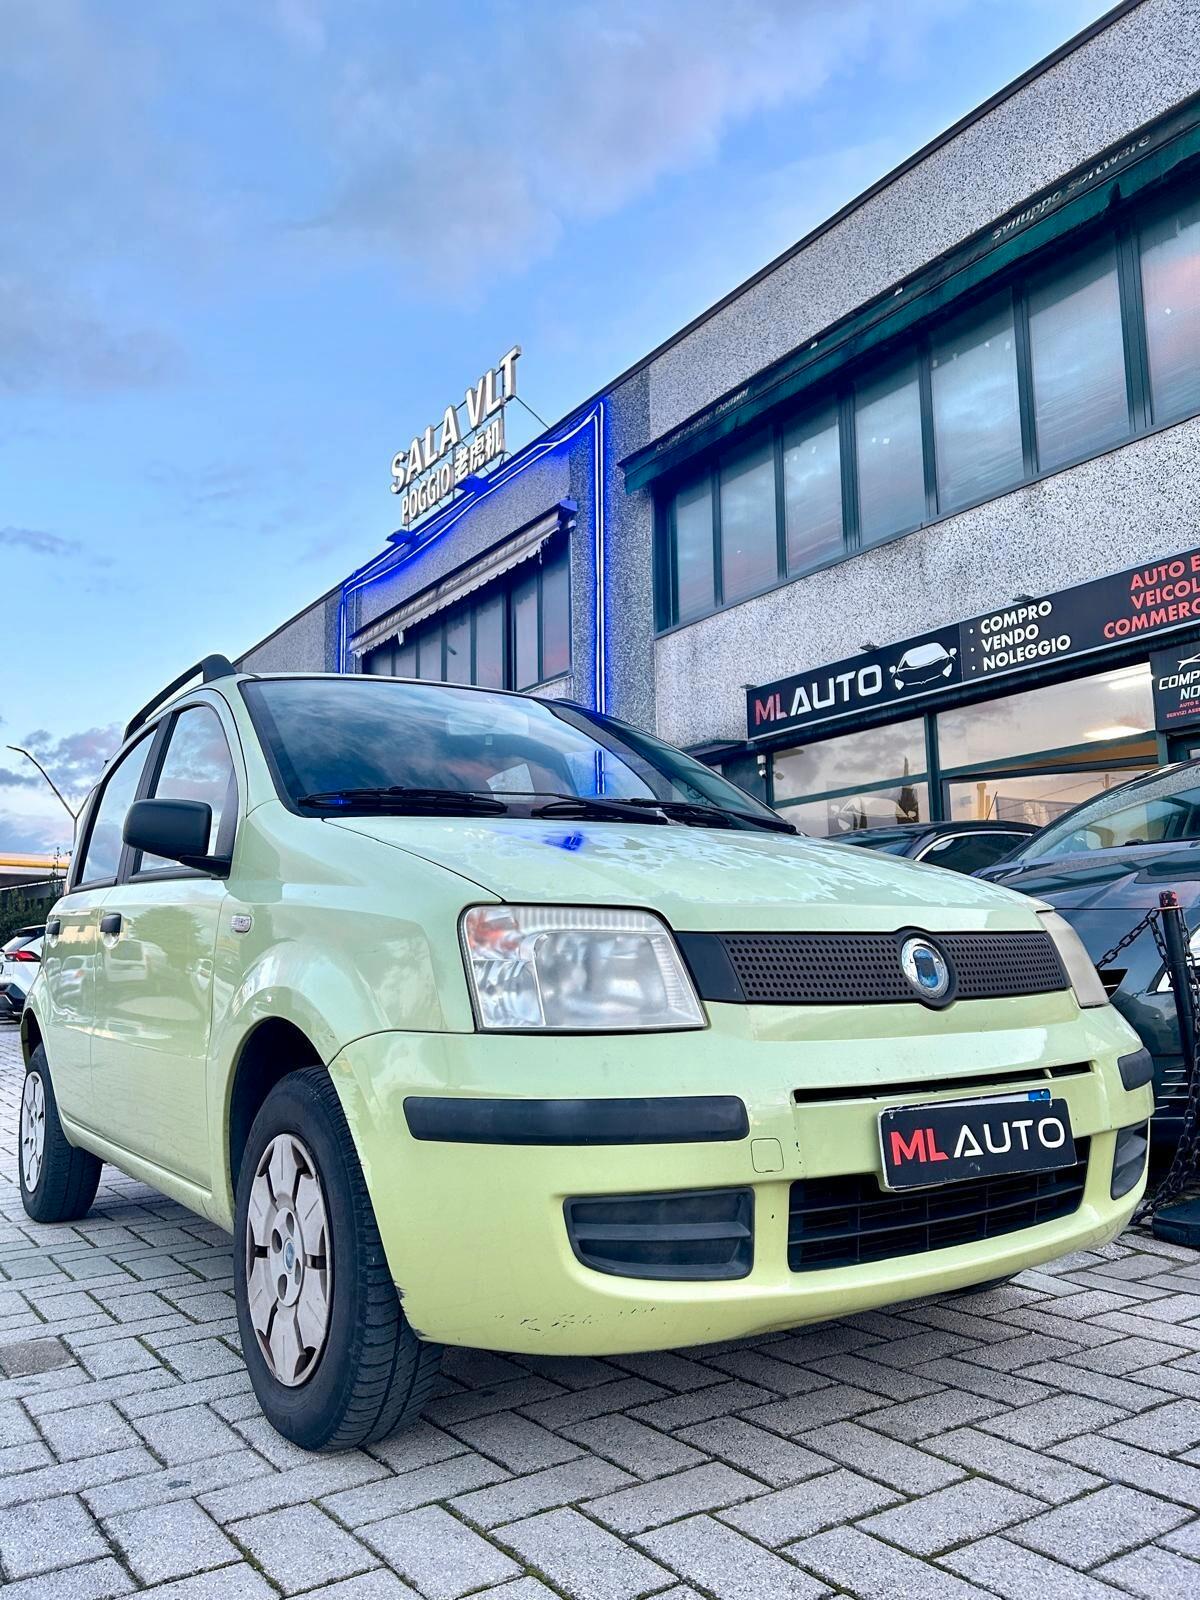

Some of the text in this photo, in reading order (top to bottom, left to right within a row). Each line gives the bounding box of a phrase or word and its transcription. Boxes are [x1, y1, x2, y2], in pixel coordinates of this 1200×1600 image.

[390, 345, 521, 494] SALA VLT
[454, 419, 504, 479] 老虎机
[401, 463, 454, 526] POGGIO
[1131, 561, 1185, 590] AUTO
[980, 600, 1052, 634] COMPRO
[981, 624, 1039, 653] VENDO
[982, 634, 1071, 671] NOLEGGIO
